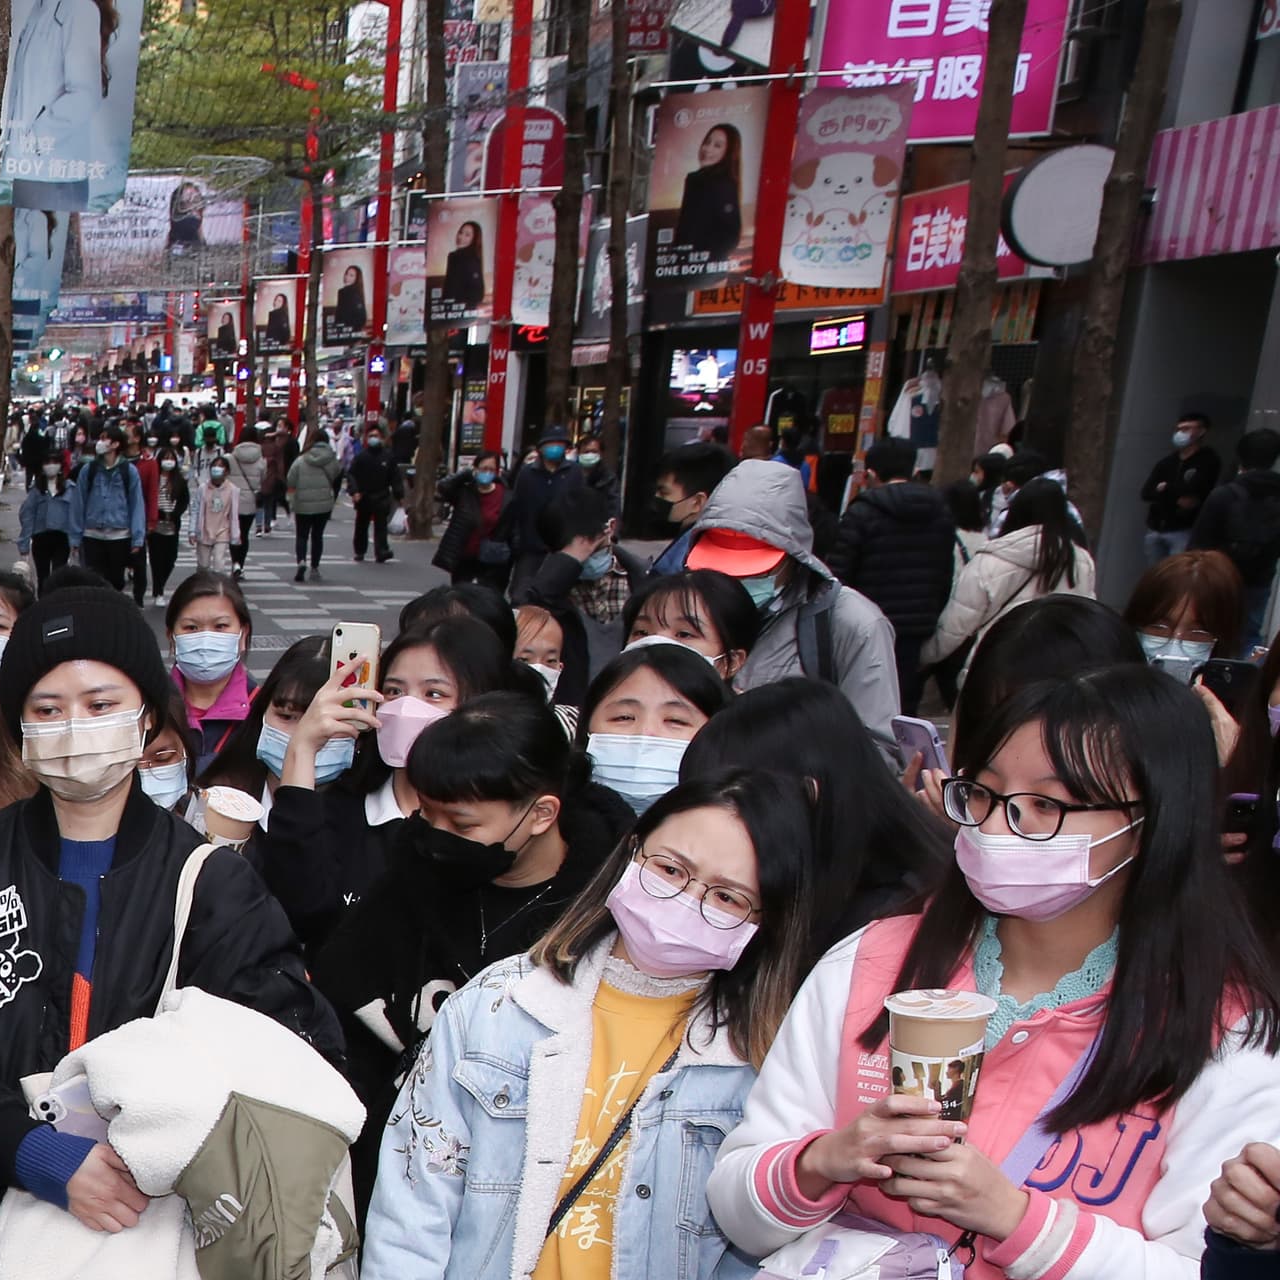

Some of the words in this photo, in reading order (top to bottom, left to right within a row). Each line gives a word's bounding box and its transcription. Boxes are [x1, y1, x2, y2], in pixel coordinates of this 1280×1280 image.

[818, 115, 893, 137] 西門町
[6, 158, 43, 176] BOY
[655, 265, 679, 277] ONE
[681, 264, 705, 275] BOY
[749, 323, 769, 340] W
[493, 349, 507, 359] W
[743, 358, 768, 375] 05
[490, 372, 506, 383] 07
